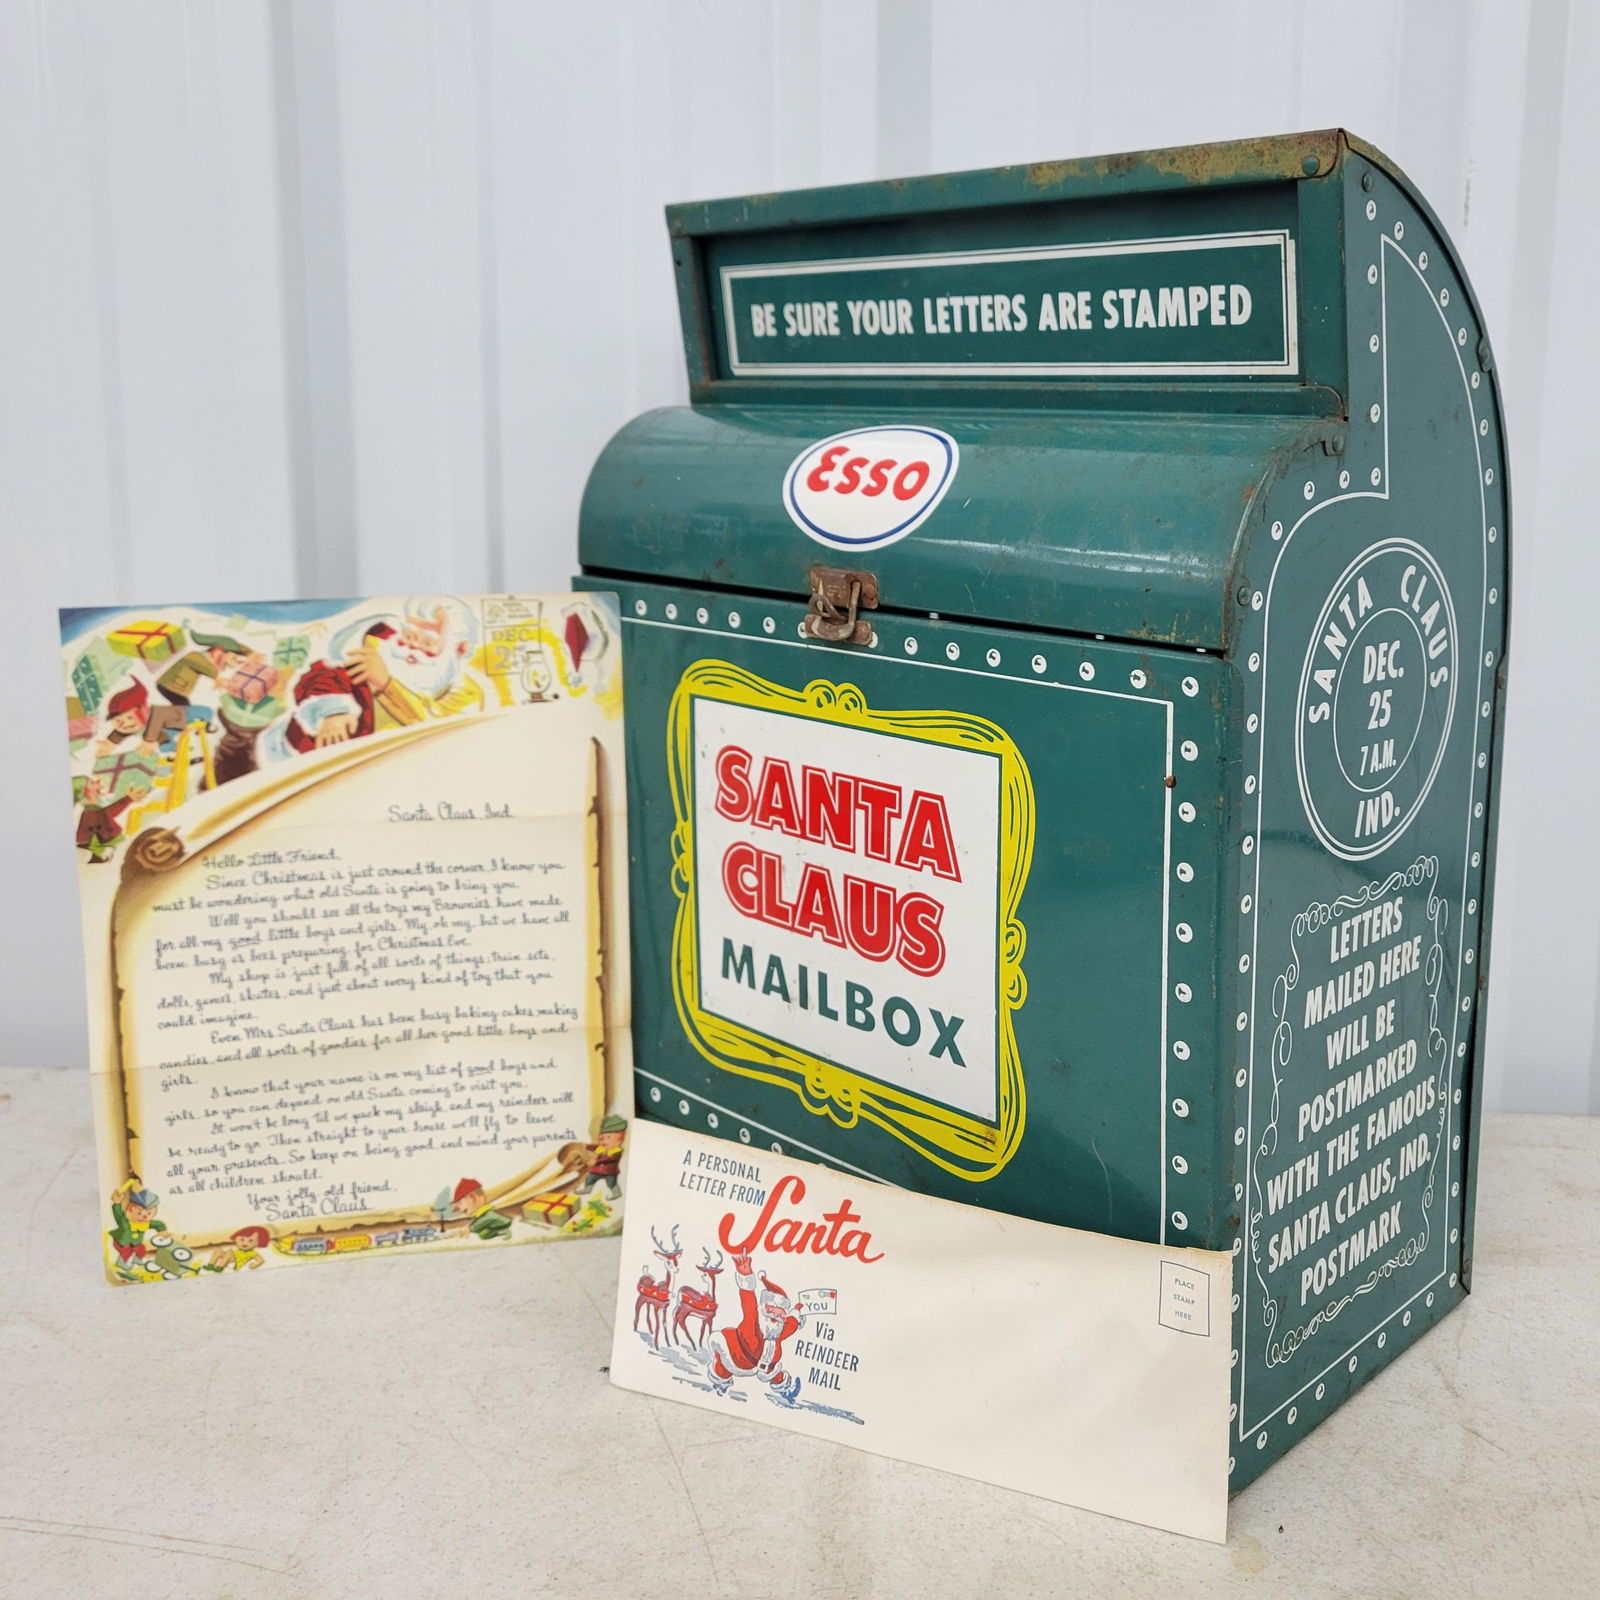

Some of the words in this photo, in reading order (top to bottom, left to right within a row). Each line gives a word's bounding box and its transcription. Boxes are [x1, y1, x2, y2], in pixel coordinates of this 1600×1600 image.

[752, 304, 776, 337] BE
[783, 300, 840, 337] SURE
[847, 298, 914, 335] YOUR
[924, 294, 1028, 334] LETTERS
[1039, 290, 1092, 332] ARE
[1103, 285, 1252, 329] STAMPED
[1308, 576, 1373, 724] SANTA
[1400, 564, 1449, 689] CLAUS
[1362, 640, 1405, 684] DEC.
[1367, 689, 1393, 730] 25
[1360, 745, 1368, 776] 7
[1369, 738, 1397, 773] A.M.
[388, 803, 434, 822] Santa
[715, 744, 963, 884] SANTA
[1354, 790, 1400, 839] IND.
[202, 855, 244, 869] Hello
[248, 851, 283, 866] Little
[206, 874, 245, 890] Since
[252, 871, 325, 885] Christmas
[331, 868, 343, 879] is
[348, 865, 373, 883] just
[378, 862, 423, 877] around
[425, 861, 443, 874] the
[491, 858, 498, 872] I
[501, 857, 535, 871] know
[538, 863, 565, 875] you
[152, 898, 186, 912] must
[190, 896, 202, 909] be
[207, 893, 278, 908] wondering
[283, 887, 315, 901] what
[319, 885, 339, 898] old
[342, 884, 381, 897] Santa
[386, 883, 397, 894] is
[401, 881, 435, 899] going
[437, 880, 450, 891] to
[454, 879, 487, 894] bring
[208, 913, 240, 927] Well
[244, 917, 268, 930] you
[273, 908, 316, 922] should
[322, 908, 341, 918] see
[345, 903, 360, 916] all
[363, 901, 381, 914] the
[385, 902, 408, 918] toys
[412, 905, 432, 918] my
[432, 897, 490, 911] Brownies
[496, 895, 524, 908] have
[528, 895, 563, 907] made
[721, 841, 946, 978] CLAUS
[155, 938, 177, 959] for
[179, 936, 197, 949] all
[202, 939, 223, 952] my
[228, 931, 262, 951] good
[269, 926, 300, 942] little
[306, 925, 336, 944] boys
[339, 921, 363, 936] and
[433, 916, 449, 928] oh
[480, 914, 500, 926] but
[502, 917, 516, 926] we
[522, 912, 550, 925] have
[553, 910, 570, 923] all
[1330, 896, 1403, 963] LETTERS
[155, 958, 188, 971] been
[194, 954, 226, 971] busy
[231, 954, 245, 963] as
[250, 948, 276, 961] bees
[282, 946, 347, 965] preparing
[350, 941, 375, 959] for
[378, 937, 443, 951] Christmas
[208, 971, 233, 989] My
[238, 968, 270, 984] shop
[275, 967, 286, 979] is
[293, 965, 321, 982] just
[326, 959, 349, 979] full
[355, 958, 369, 976] of
[372, 956, 388, 969] all
[395, 954, 425, 967] sorts
[429, 954, 442, 970] of
[491, 951, 520, 962] train
[289, 983, 313, 997] and
[318, 979, 341, 999] just
[347, 977, 378, 990] about
[384, 978, 416, 991] every
[421, 971, 452, 984] kind
[455, 970, 468, 987] of
[471, 970, 491, 986] toy
[494, 967, 521, 980] that
[526, 972, 553, 984] you
[1304, 966, 1376, 1029] MAILED
[1379, 935, 1422, 989] HERE
[721, 936, 967, 1068] MAILBOX
[158, 1014, 196, 1030] could
[210, 1030, 241, 1044] Even
[278, 1021, 316, 1037] Santa
[319, 1018, 354, 1032] Claus
[362, 1014, 383, 1027] has
[388, 1012, 416, 1024] been
[420, 1008, 451, 1023] busy
[455, 1005, 497, 1022] baking
[537, 1002, 578, 1020] making
[1325, 1025, 1370, 1070] WILL
[1375, 999, 1396, 1038] BE
[1299, 1038, 1417, 1144] POSTMARKED
[1266, 1153, 1319, 1216] WITH
[1326, 1122, 1360, 1168] THE
[1366, 1075, 1436, 1153] FAMOUS
[683, 1149, 692, 1166] A
[698, 1152, 762, 1183] PERSONAL
[169, 1186, 183, 1194] as
[188, 1180, 205, 1193] all
[210, 1176, 264, 1190] children
[247, 1193, 280, 1211] Your
[324, 1183, 344, 1196] old
[679, 1171, 727, 1199] LETTER
[729, 1183, 766, 1207] FROM
[266, 1203, 316, 1220] Santa
[320, 1198, 373, 1216] Claus
[718, 1175, 885, 1264] Santa
[1267, 1209, 1330, 1274] SANTA
[1335, 1162, 1397, 1226] CLAUS,
[1400, 1132, 1432, 1186] IND.
[1301, 1200, 1402, 1307] POSTMARK
[1173, 1294, 1195, 1305] STAMP
[1174, 1278, 1195, 1290] PLACE
[805, 1302, 828, 1313] YOU
[1174, 1310, 1192, 1321] HERE
[815, 1321, 835, 1341] Via
[795, 1340, 859, 1372] REINDEER
[808, 1367, 841, 1391] MAIL
